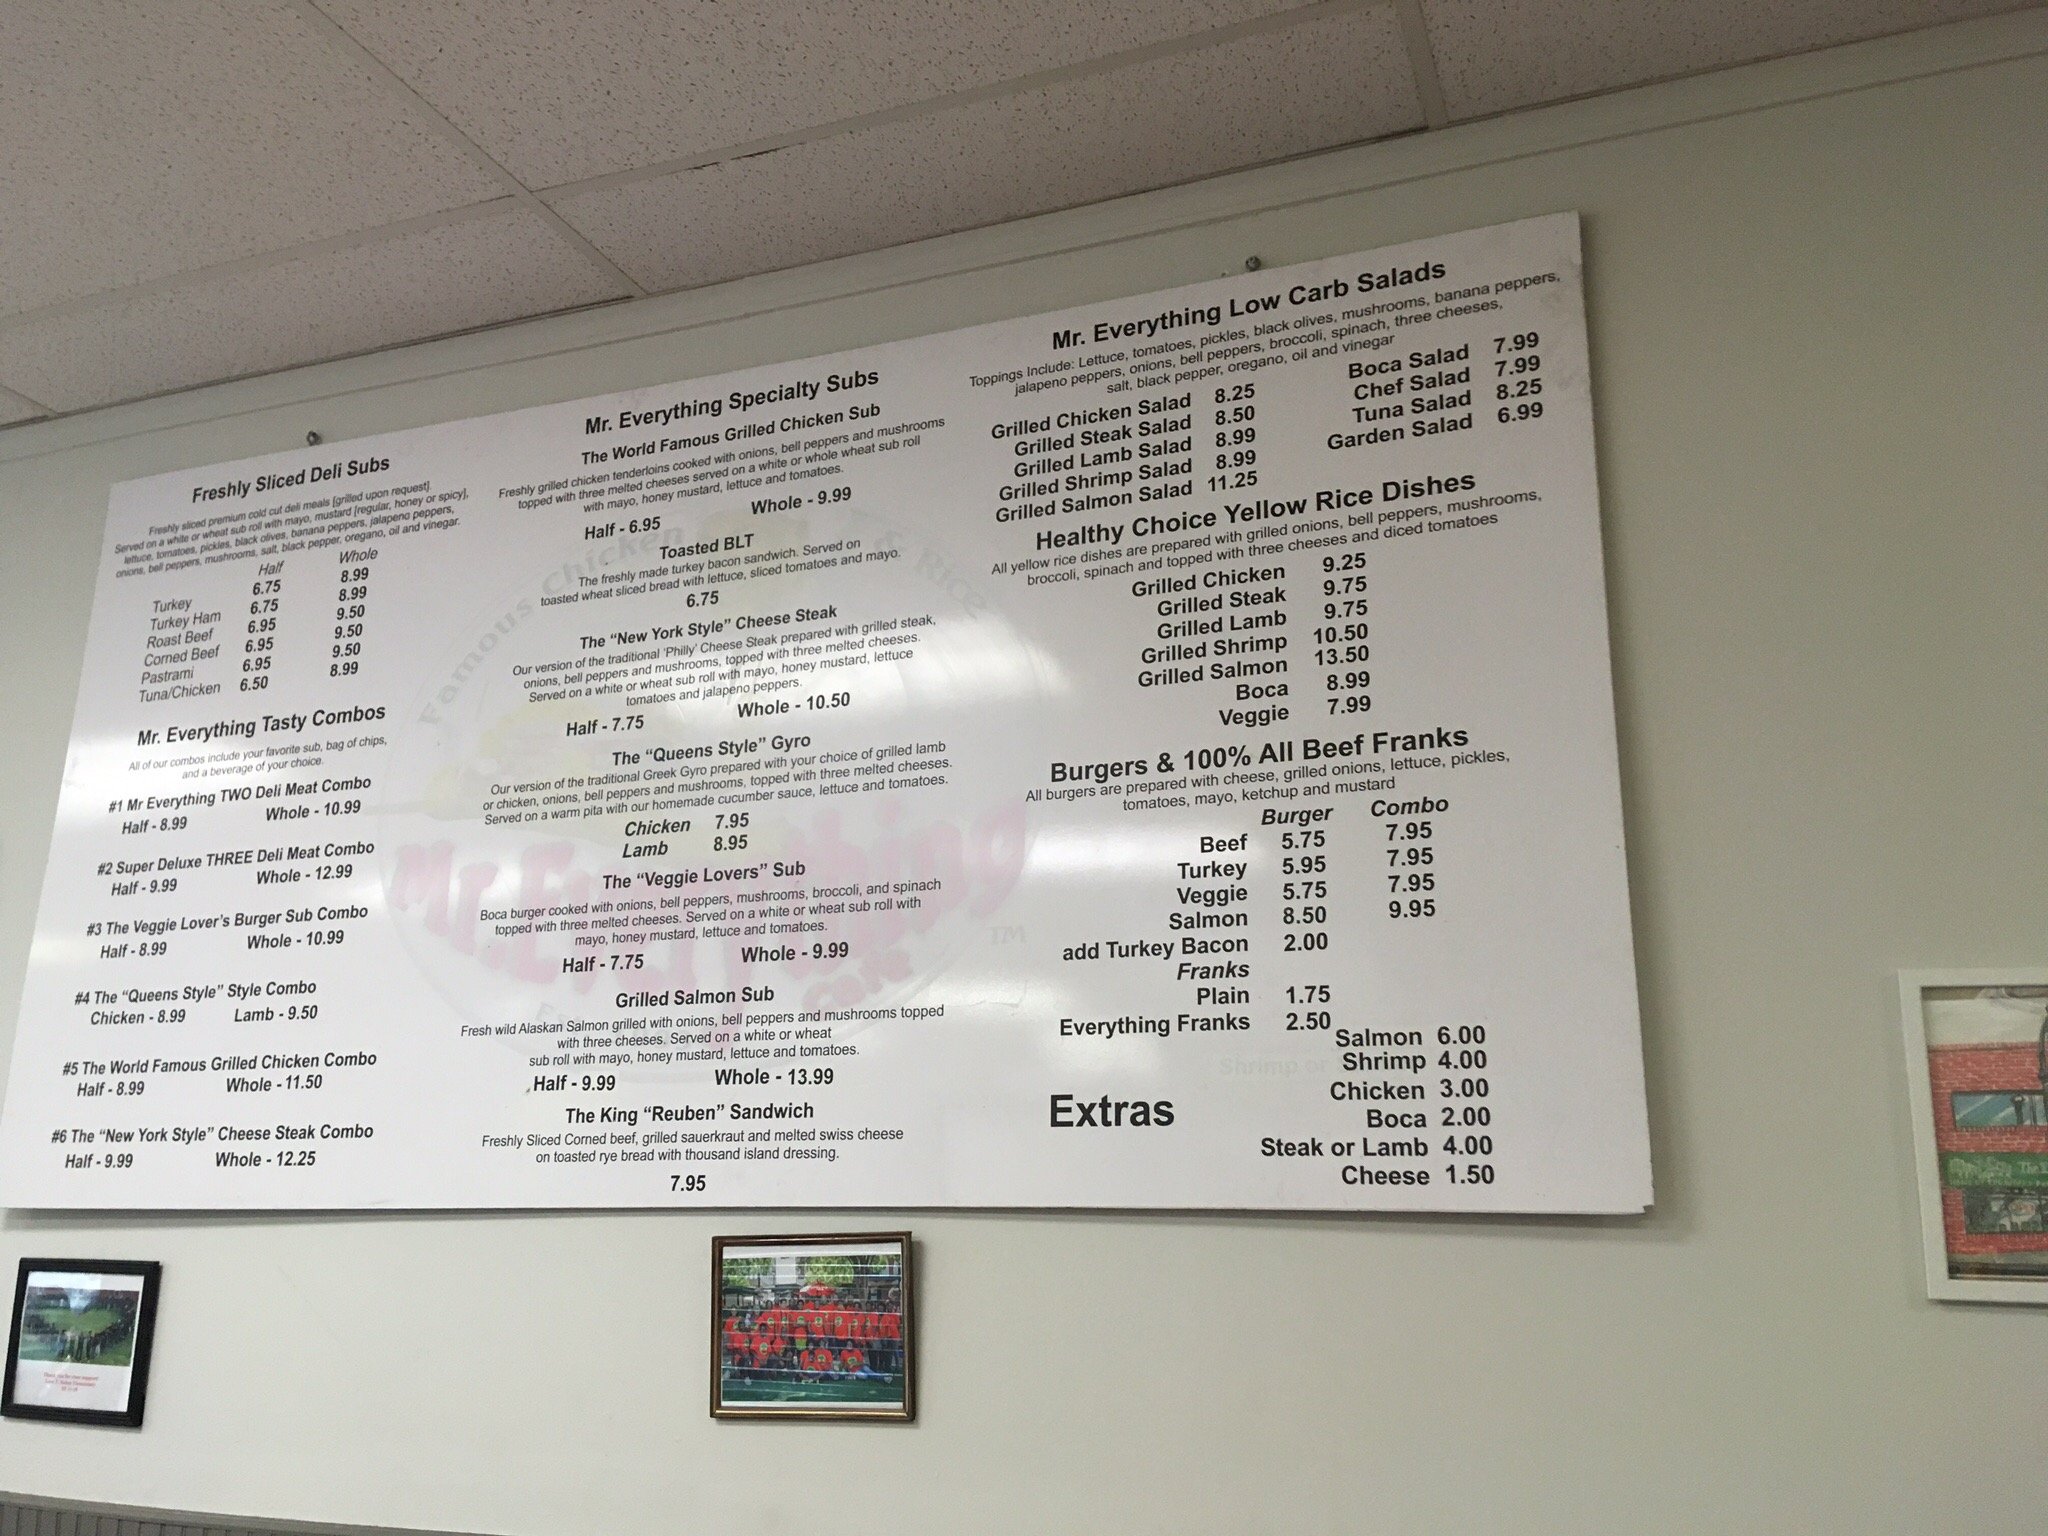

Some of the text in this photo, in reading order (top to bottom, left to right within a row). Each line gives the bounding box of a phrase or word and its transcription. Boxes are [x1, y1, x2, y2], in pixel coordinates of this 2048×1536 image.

[1052, 261, 1446, 350] Mr. Everything Low Carb Salads
[1106, 334, 1396, 394] salt, black pepper, oregano, oil and vinegar
[1348, 331, 1540, 380] Boca Salad 7.99
[585, 370, 879, 435] Mr. Everything Specialty Subs
[991, 382, 1256, 439] Grilled Chicken Salad 8.25
[581, 403, 881, 465] The World Famous Grilled Chicken Sub
[192, 456, 390, 504] Freshly Sliced Deli Subs
[1036, 474, 1476, 551] Healthy Choice Yellow Rice Dishes
[257, 547, 379, 576] Half Whole
[659, 533, 755, 560] Toasted BLT
[152, 566, 370, 614] Turkey 6.75 8.99
[540, 549, 902, 607] toasted wheat sliced bread with lettuce, sliced tomatoes and mayo.
[1131, 552, 1367, 597] Grilled Chicken 9.25
[139, 661, 359, 703] Tuna/Chicken 6.50 8.99
[137, 705, 386, 746] Mr. Everything Tasty Combos
[128, 736, 388, 771] All of our combos include your favorite sub, bag of chips,
[611, 751, 641, 766] The
[771, 735, 811, 753] Gyro
[1051, 726, 1469, 784] Burgers & 100% All Beef Franks
[108, 776, 372, 814] #1 Mr Everything TWO Deli Meat Combo
[1122, 775, 1396, 811] tomatoes, mayo, ketchup and mustard
[624, 812, 750, 837] Chicken 7.95
[1260, 796, 1449, 828] Burger Combo
[1200, 820, 1433, 854] Beef 5.75 7.95
[1062, 932, 1329, 961] add Turkey Bacon 2.00
[615, 985, 775, 1009] Grilled Salmon Sub
[1060, 1011, 1331, 1040] Everything Franks 2.50
[1335, 1025, 1486, 1048] Salmon 6.00
[565, 1107, 596, 1124] The
[600, 1106, 638, 1127] King
[729, 1101, 814, 1120] Sandwich
[1050, 1093, 1175, 1128] Extras
[51, 1129, 68, 1144] #6
[71, 1128, 95, 1143] The
[138, 1127, 168, 1143] York
[217, 1126, 271, 1141] Cheese
[274, 1124, 316, 1141] Steak
[319, 1123, 374, 1140] Combo
[1260, 1135, 1493, 1157] Steak or Lamb 4.00
[64, 1153, 94, 1169] Half
[104, 1153, 134, 1169] 9.99
[215, 1151, 262, 1167] Whole
[276, 1150, 317, 1167] 12.25
[535, 1146, 840, 1165] on toasted rye bread with thousand island dressing.
[670, 1174, 706, 1192] 7.95
